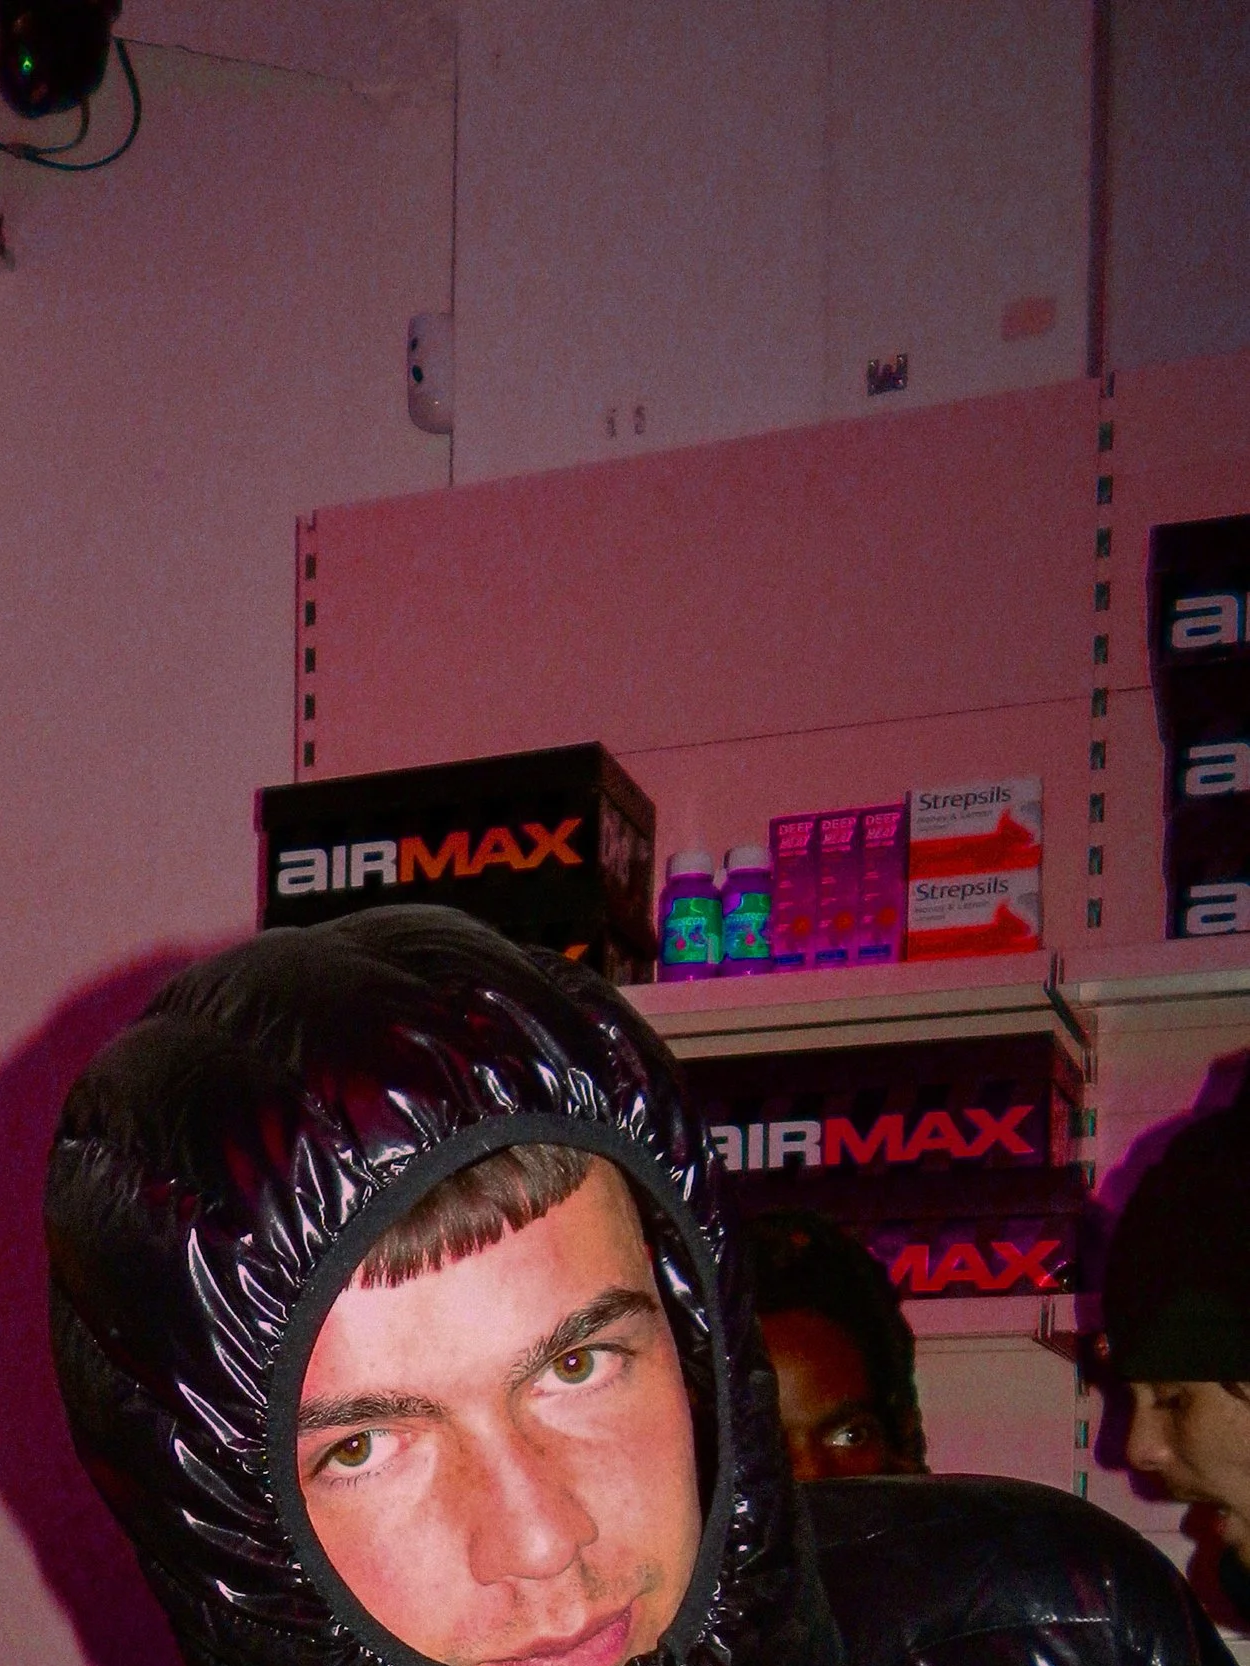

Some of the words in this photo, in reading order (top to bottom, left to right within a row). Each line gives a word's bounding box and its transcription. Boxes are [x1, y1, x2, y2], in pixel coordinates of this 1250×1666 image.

[919, 786, 1012, 811] Strepsils
[822, 816, 856, 830] DEEP
[865, 812, 901, 826] DEEP
[779, 821, 814, 835] DEEP
[915, 877, 1009, 901] Strepsils
